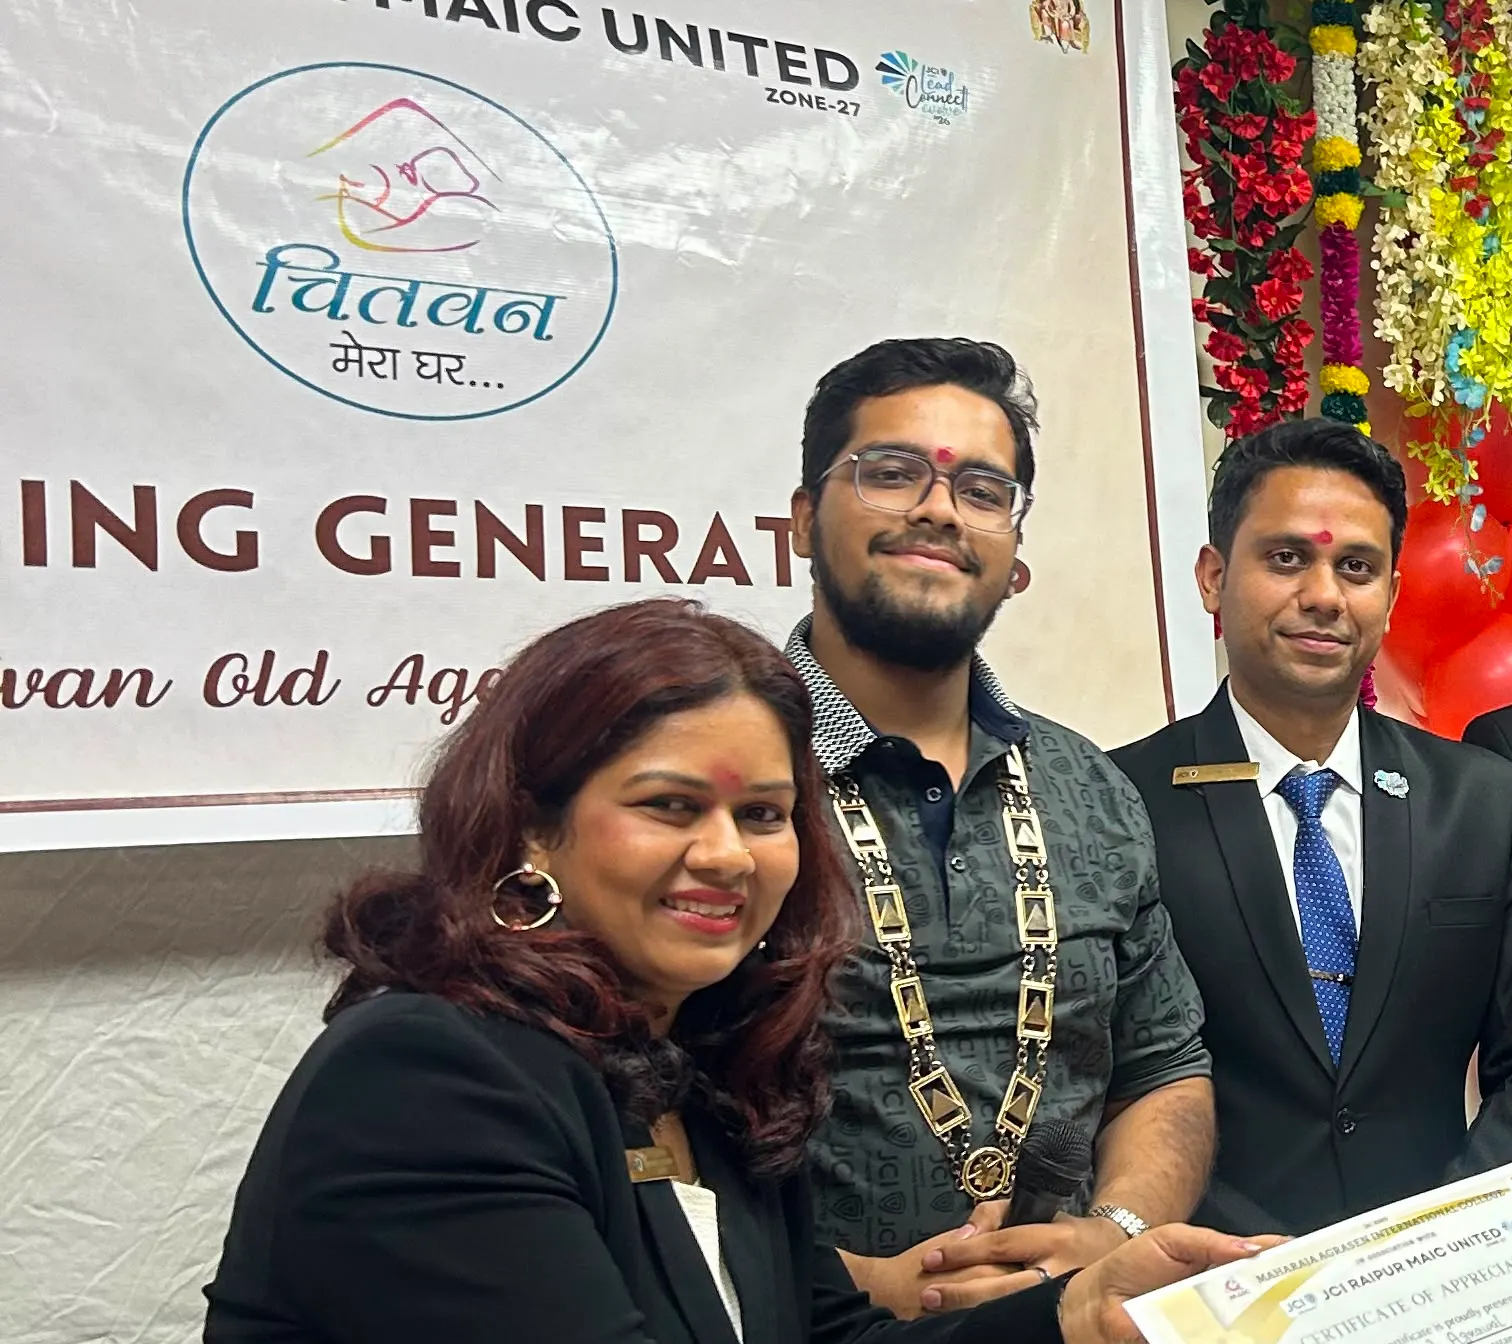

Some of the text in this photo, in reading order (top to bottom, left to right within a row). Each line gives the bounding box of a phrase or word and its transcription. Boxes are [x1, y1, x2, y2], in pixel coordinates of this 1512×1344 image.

[601, 8, 860, 92] UNITED
[765, 88, 861, 117] ZONE-27
[252, 243, 567, 341] चितवन
[329, 330, 400, 380] मेरा
[21, 479, 1031, 594] ING GENERAT
[204, 649, 341, 709] Old
[1318, 1235, 1371, 1261] AGRASEN
[1323, 1228, 1502, 1300] JCI RAIPUR MAIC UNITED
[1411, 1289, 1433, 1306] OF
[1444, 1308, 1482, 1330] proudly
